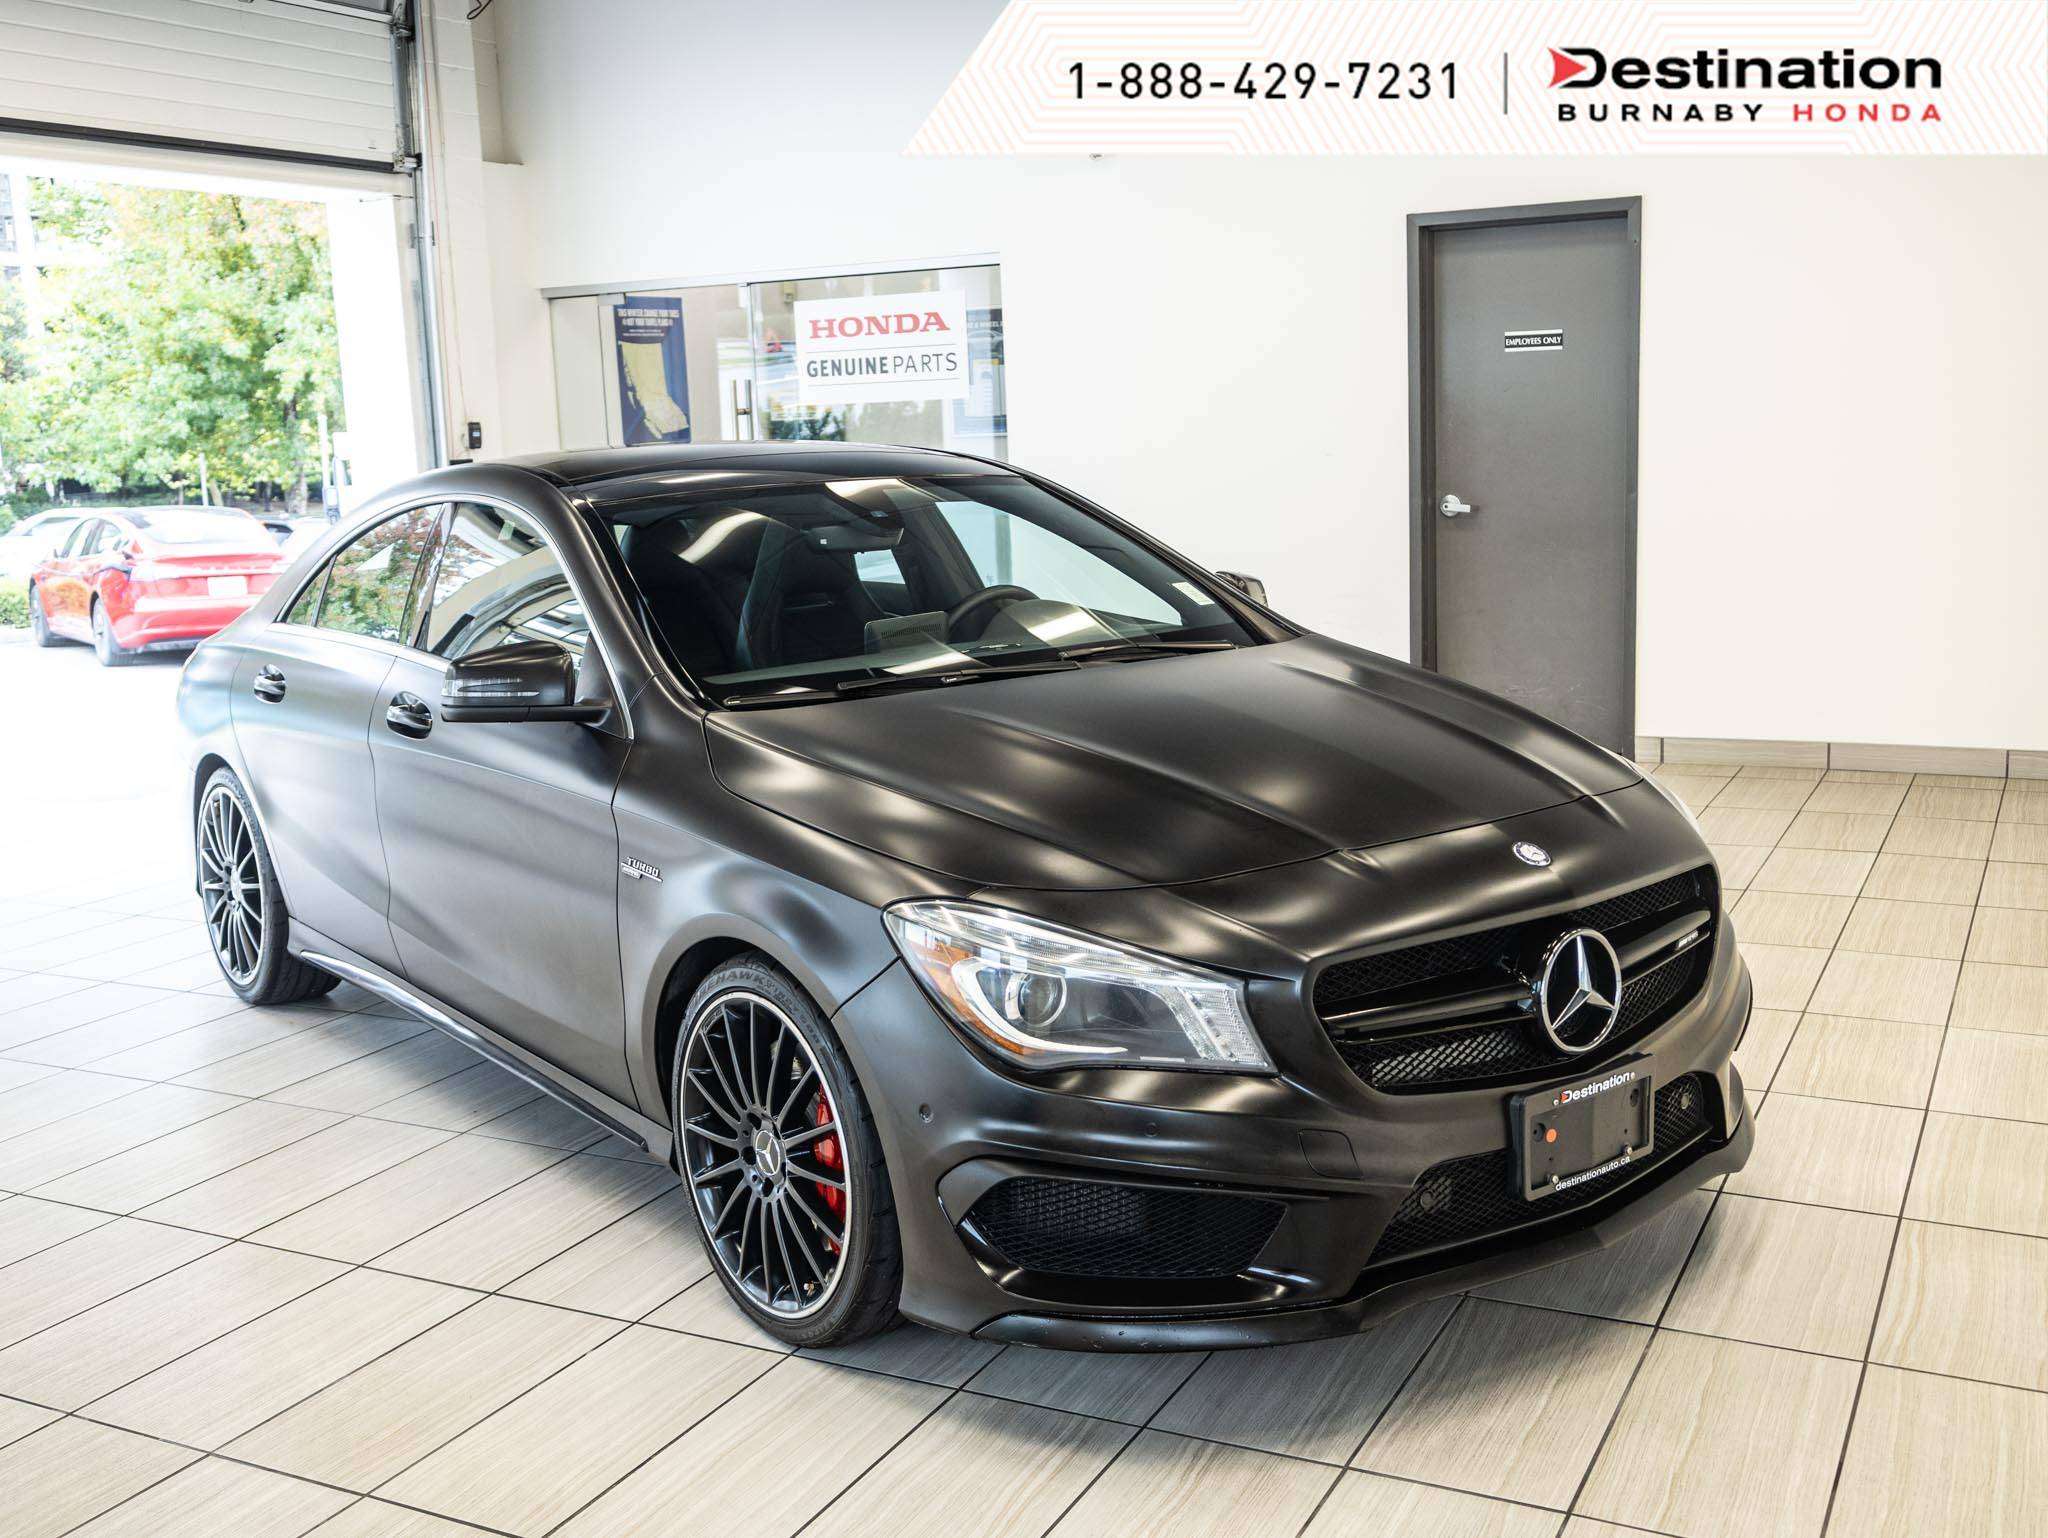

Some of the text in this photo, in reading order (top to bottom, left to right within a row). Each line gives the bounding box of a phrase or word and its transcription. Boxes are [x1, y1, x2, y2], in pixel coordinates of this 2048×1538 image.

[808, 311, 951, 339] HONDA
[1505, 336, 1561, 346] EMPLOYEES ONLY
[806, 351, 958, 378] GENUINE PARTS
[627, 856, 660, 878] TURBO
[1561, 1071, 1630, 1104] Destination
[1555, 1154, 1632, 1191] destinationauto.ca
